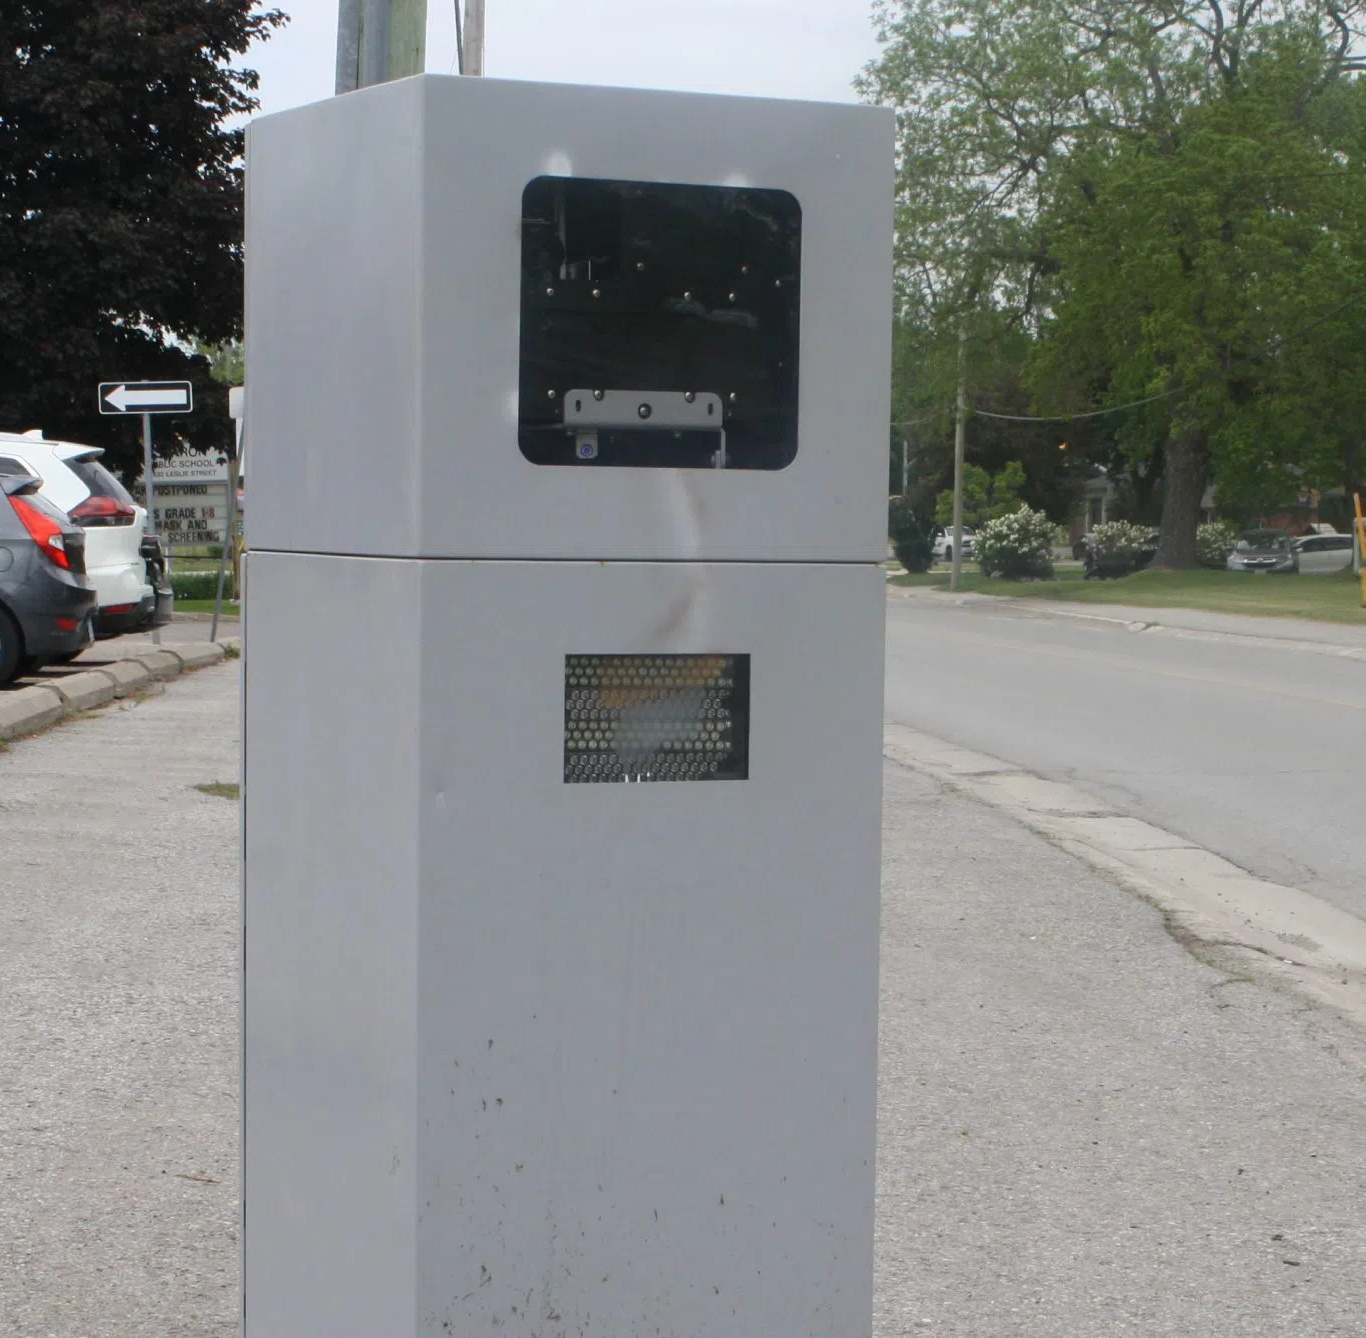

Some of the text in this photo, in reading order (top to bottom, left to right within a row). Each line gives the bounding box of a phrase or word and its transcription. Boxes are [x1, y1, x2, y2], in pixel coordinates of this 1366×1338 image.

[179, 459, 215, 469] SCHOOL
[166, 470, 189, 478] LESLIE
[191, 469, 217, 477] STREET
[153, 484, 208, 496] POSTPONED
[165, 507, 196, 519] GRADE
[201, 506, 215, 519] 1-8
[155, 519, 208, 531] MASK AND
[168, 530, 220, 544] SCREENING
